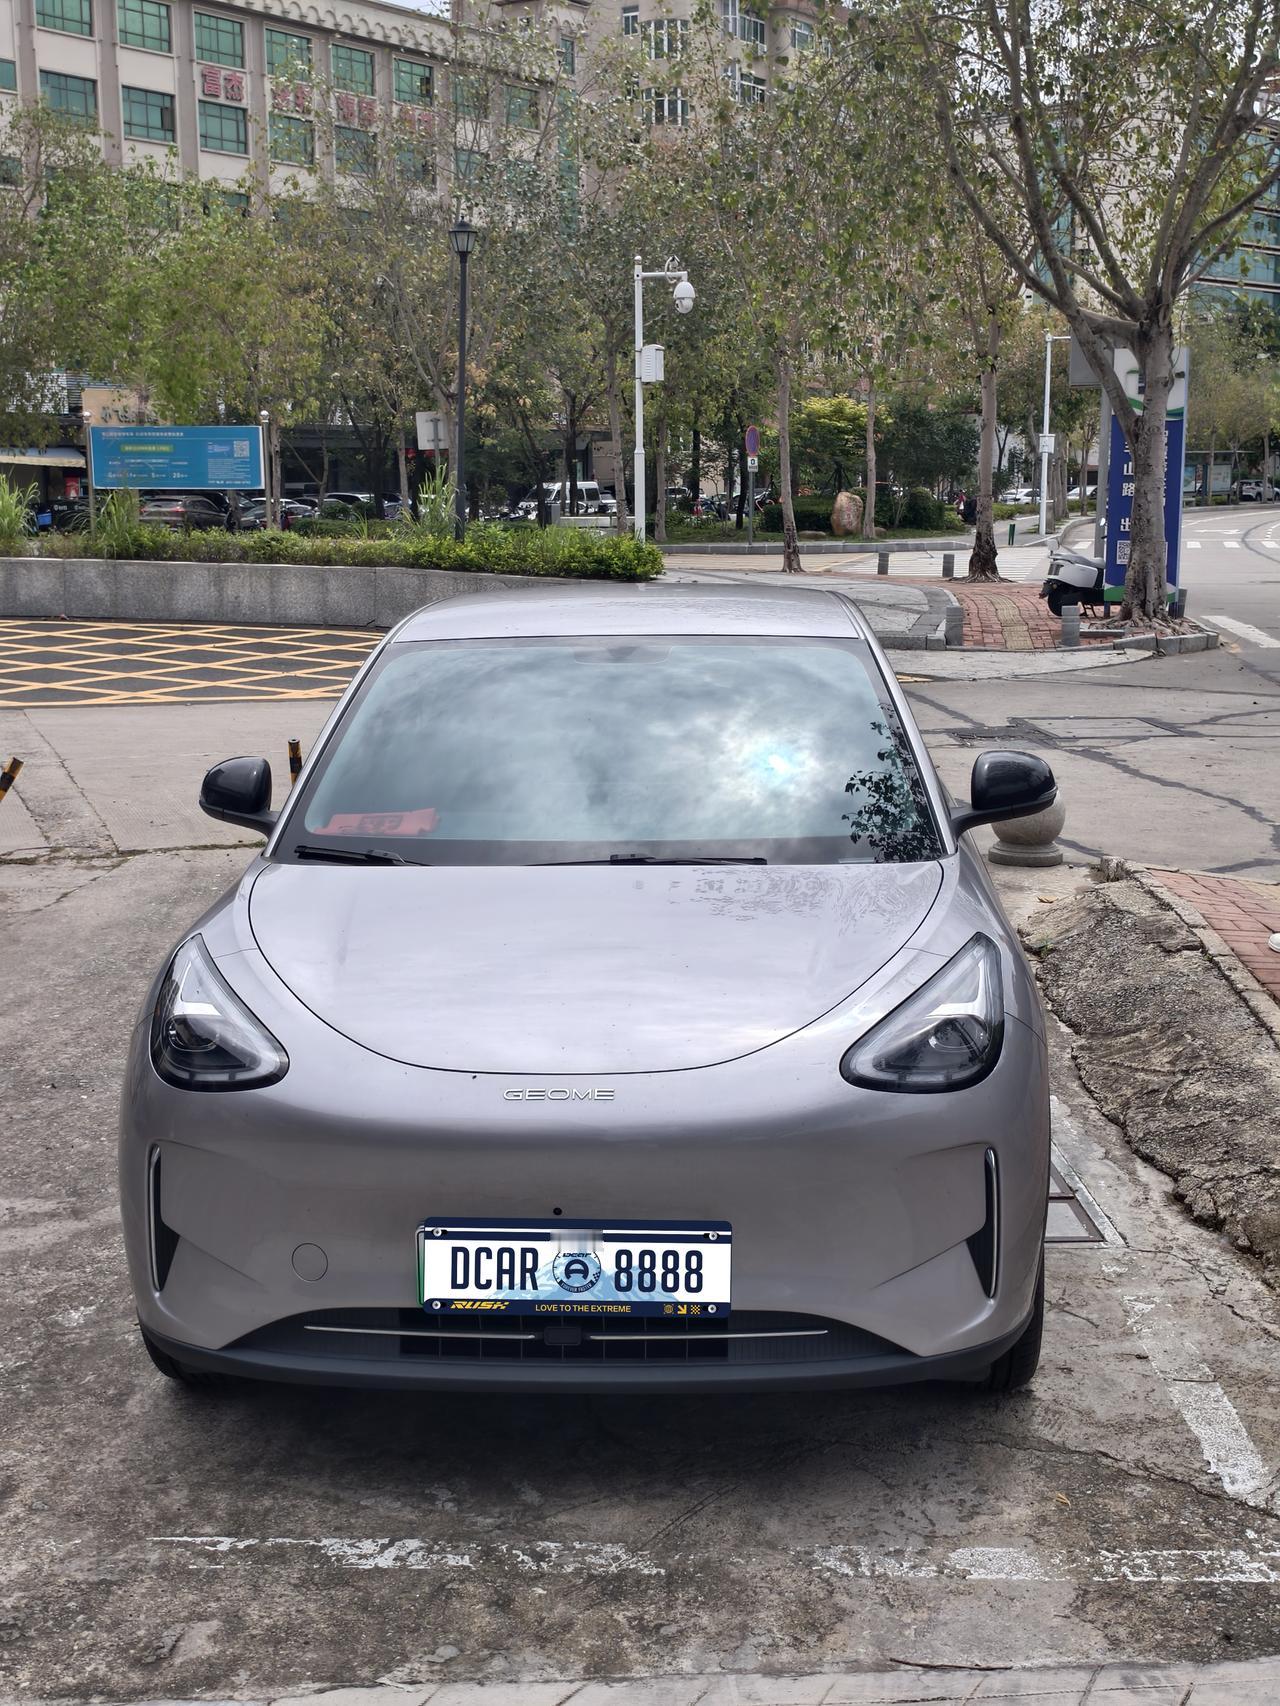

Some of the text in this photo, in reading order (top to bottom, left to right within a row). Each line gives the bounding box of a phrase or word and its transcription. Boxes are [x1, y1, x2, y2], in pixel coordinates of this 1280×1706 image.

[503, 1088, 616, 1101] GEOME
[450, 1246, 703, 1294] DCAR 8888
[535, 1304, 558, 1312] LOVE
[560, 1304, 571, 1312] TO
[590, 1305, 632, 1313] EXTREME
